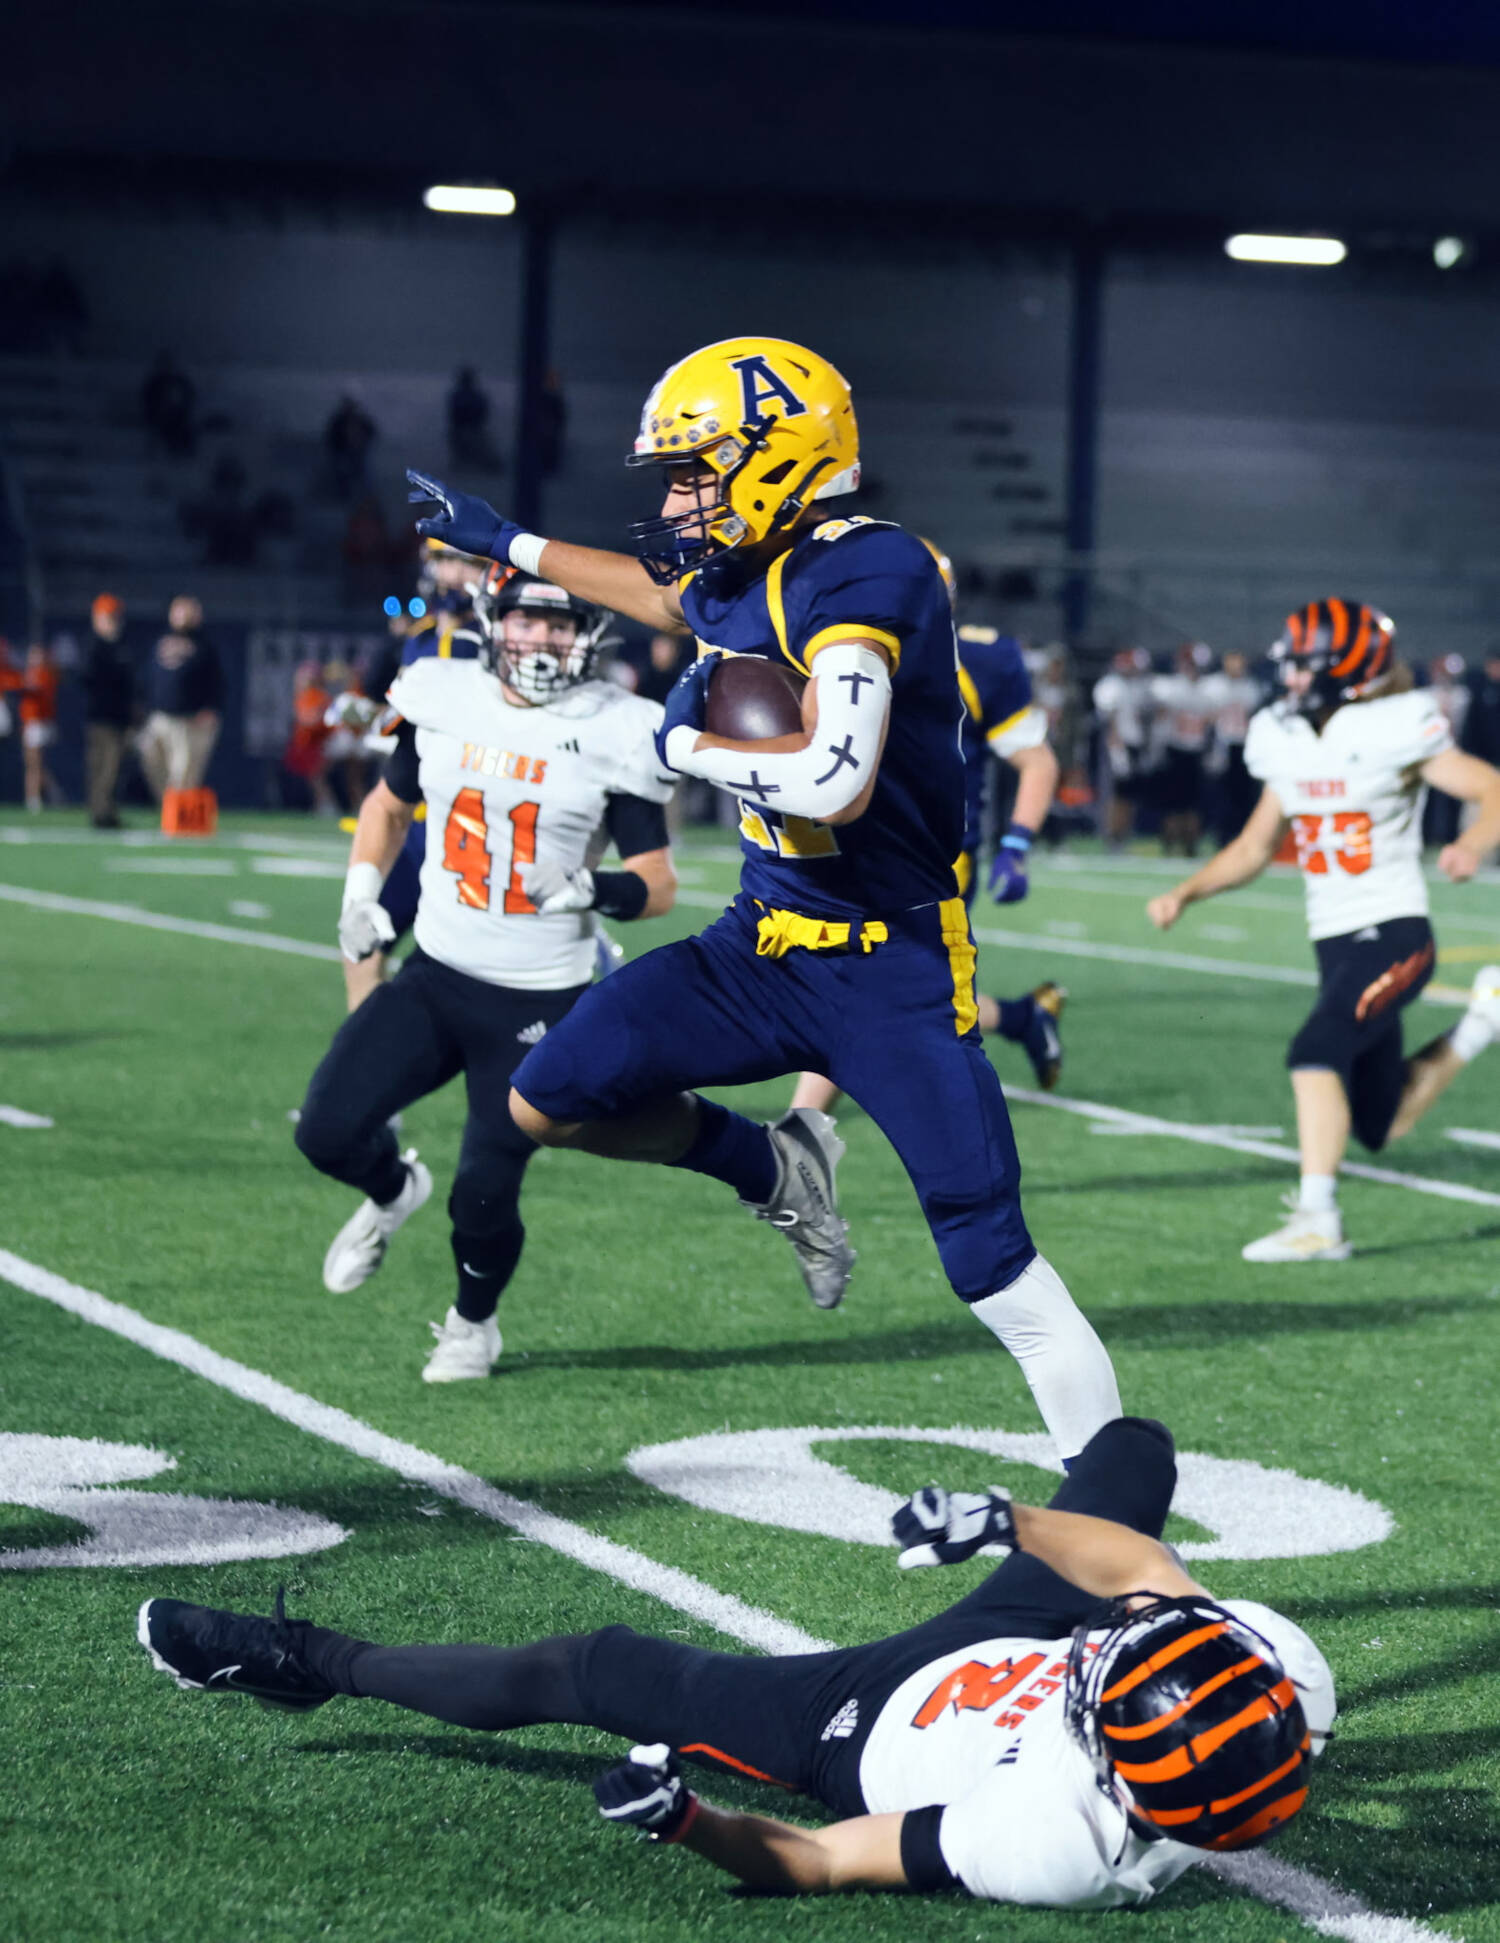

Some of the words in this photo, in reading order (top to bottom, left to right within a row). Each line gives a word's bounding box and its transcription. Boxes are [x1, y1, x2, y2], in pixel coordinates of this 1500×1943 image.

[728, 354, 810, 427] A
[460, 742, 548, 785] TIGERS
[442, 786, 541, 915] 41
[820, 1698, 859, 1742] adidas
